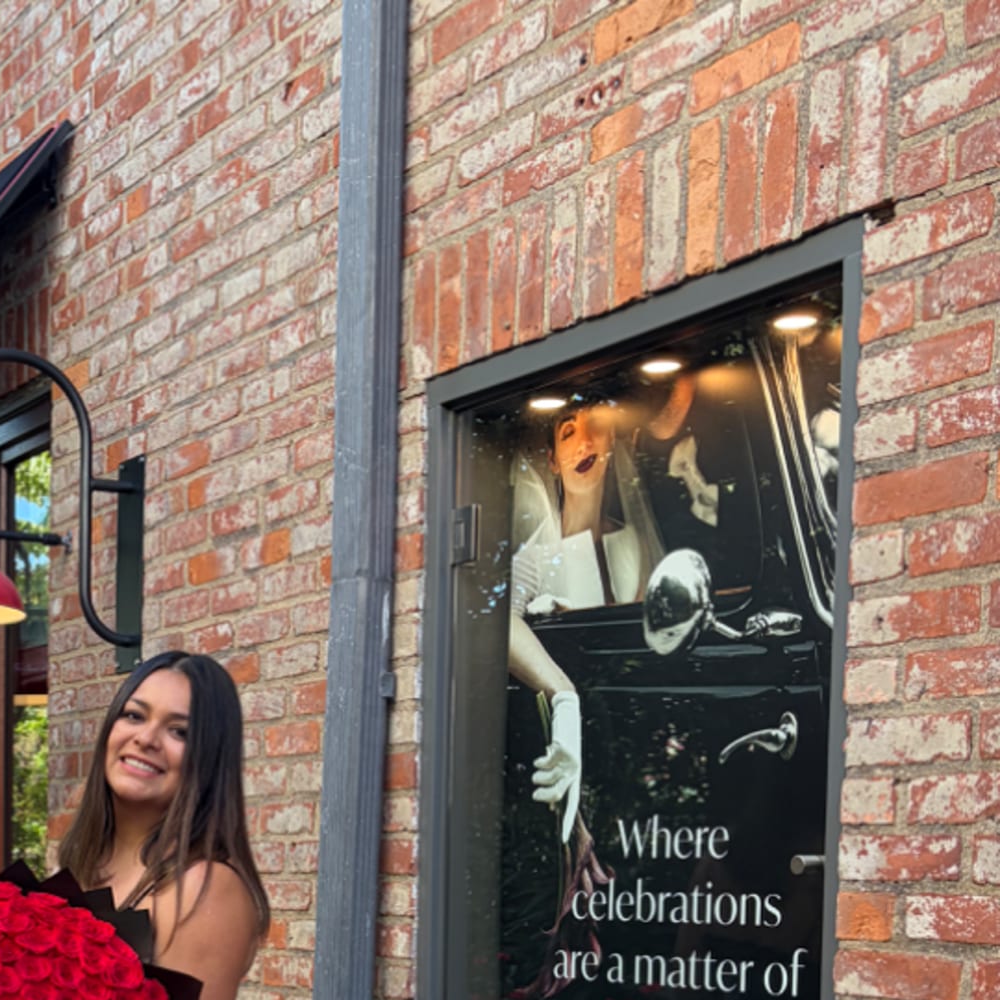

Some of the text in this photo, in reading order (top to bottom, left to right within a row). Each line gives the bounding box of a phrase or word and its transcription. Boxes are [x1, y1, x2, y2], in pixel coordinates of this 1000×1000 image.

[617, 814, 730, 860] Where
[571, 877, 782, 927] celebrations
[552, 947, 809, 998] are a matter of
